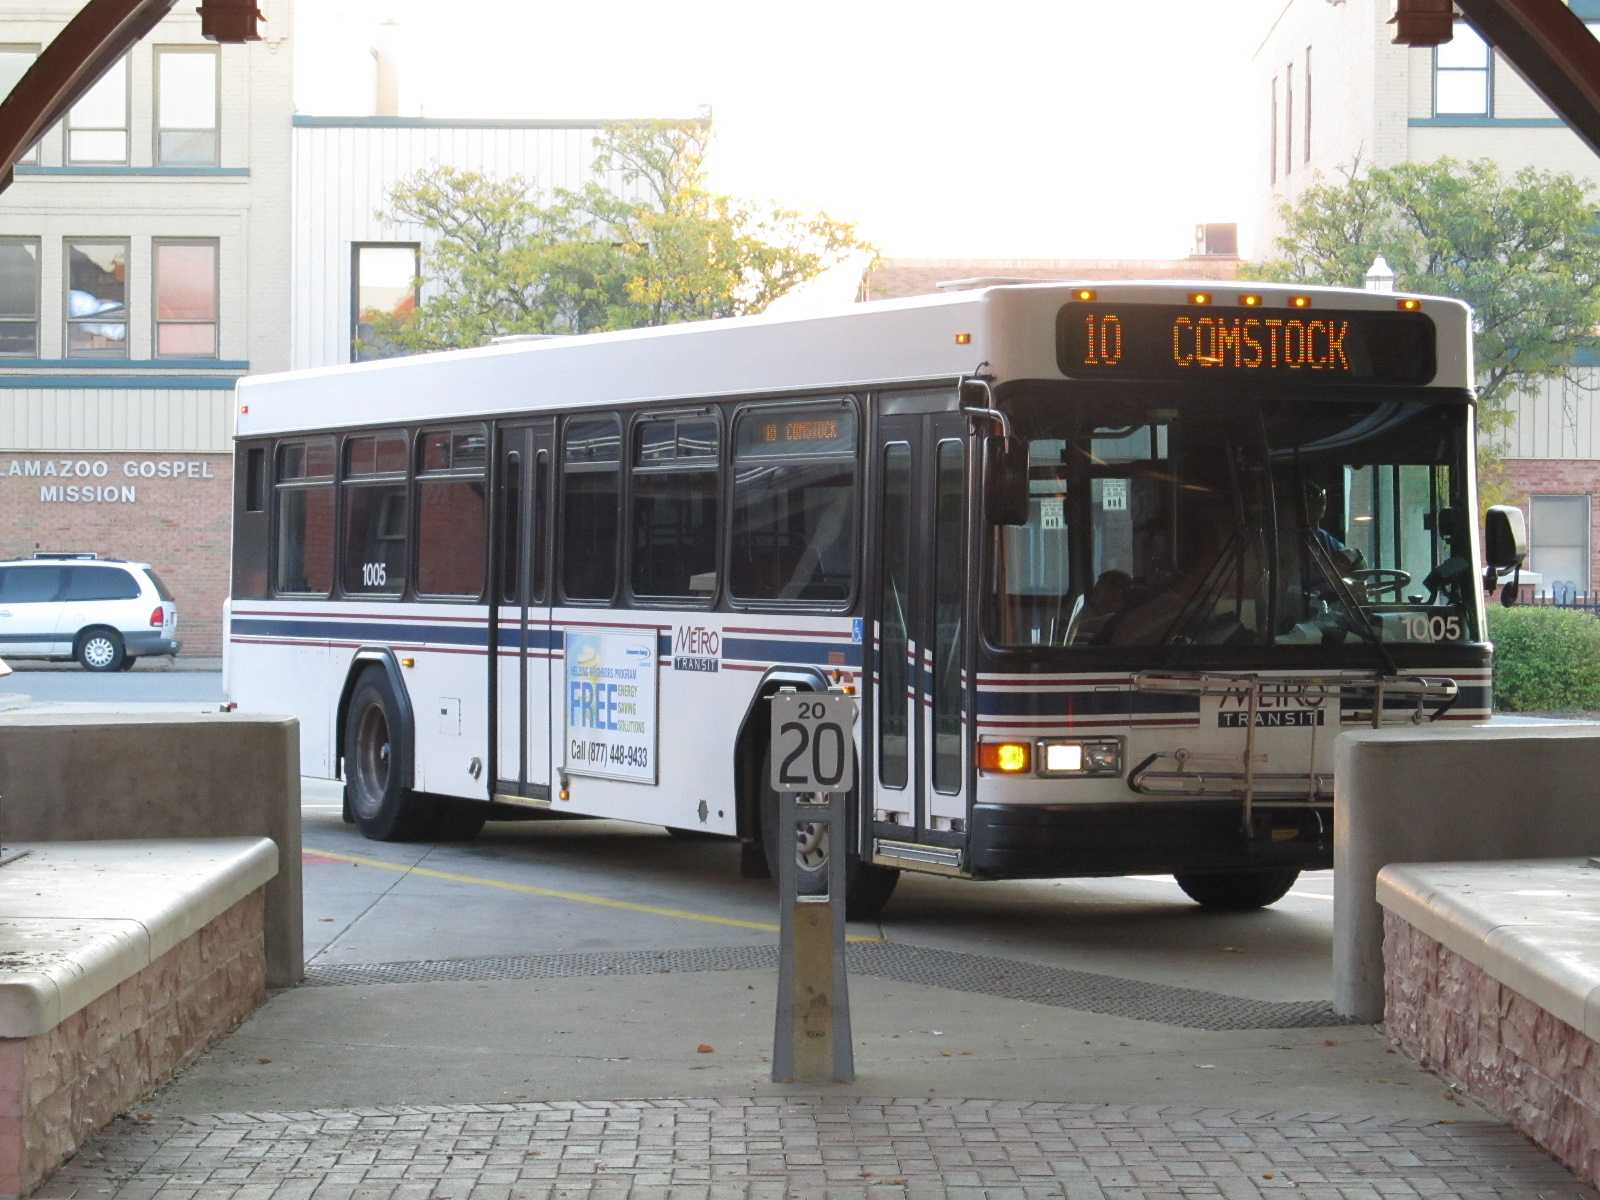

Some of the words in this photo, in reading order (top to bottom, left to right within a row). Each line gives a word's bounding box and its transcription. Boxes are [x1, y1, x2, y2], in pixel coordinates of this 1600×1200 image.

[1085, 313, 1121, 367] 10
[1173, 316, 1351, 369] COMSTOCK
[123, 461, 214, 478] GOSPEL
[40, 486, 136, 502] MISSION
[362, 562, 386, 586] 1005
[1401, 616, 1460, 640] 1005
[675, 624, 719, 655] METRO
[676, 658, 717, 671] TRANSIT
[615, 668, 637, 680] PROGRAM
[618, 684, 638, 697] ENERGY
[571, 681, 617, 730] FREE
[618, 702, 636, 715] SAVING
[798, 702, 826, 719] 20
[618, 720, 645, 734] SOLUTIONS
[1223, 711, 1316, 726] TRANSIT
[571, 739, 585, 760] Call
[588, 742, 608, 767] (877)
[610, 743, 648, 768] 448-9433
[779, 721, 845, 785] 20
